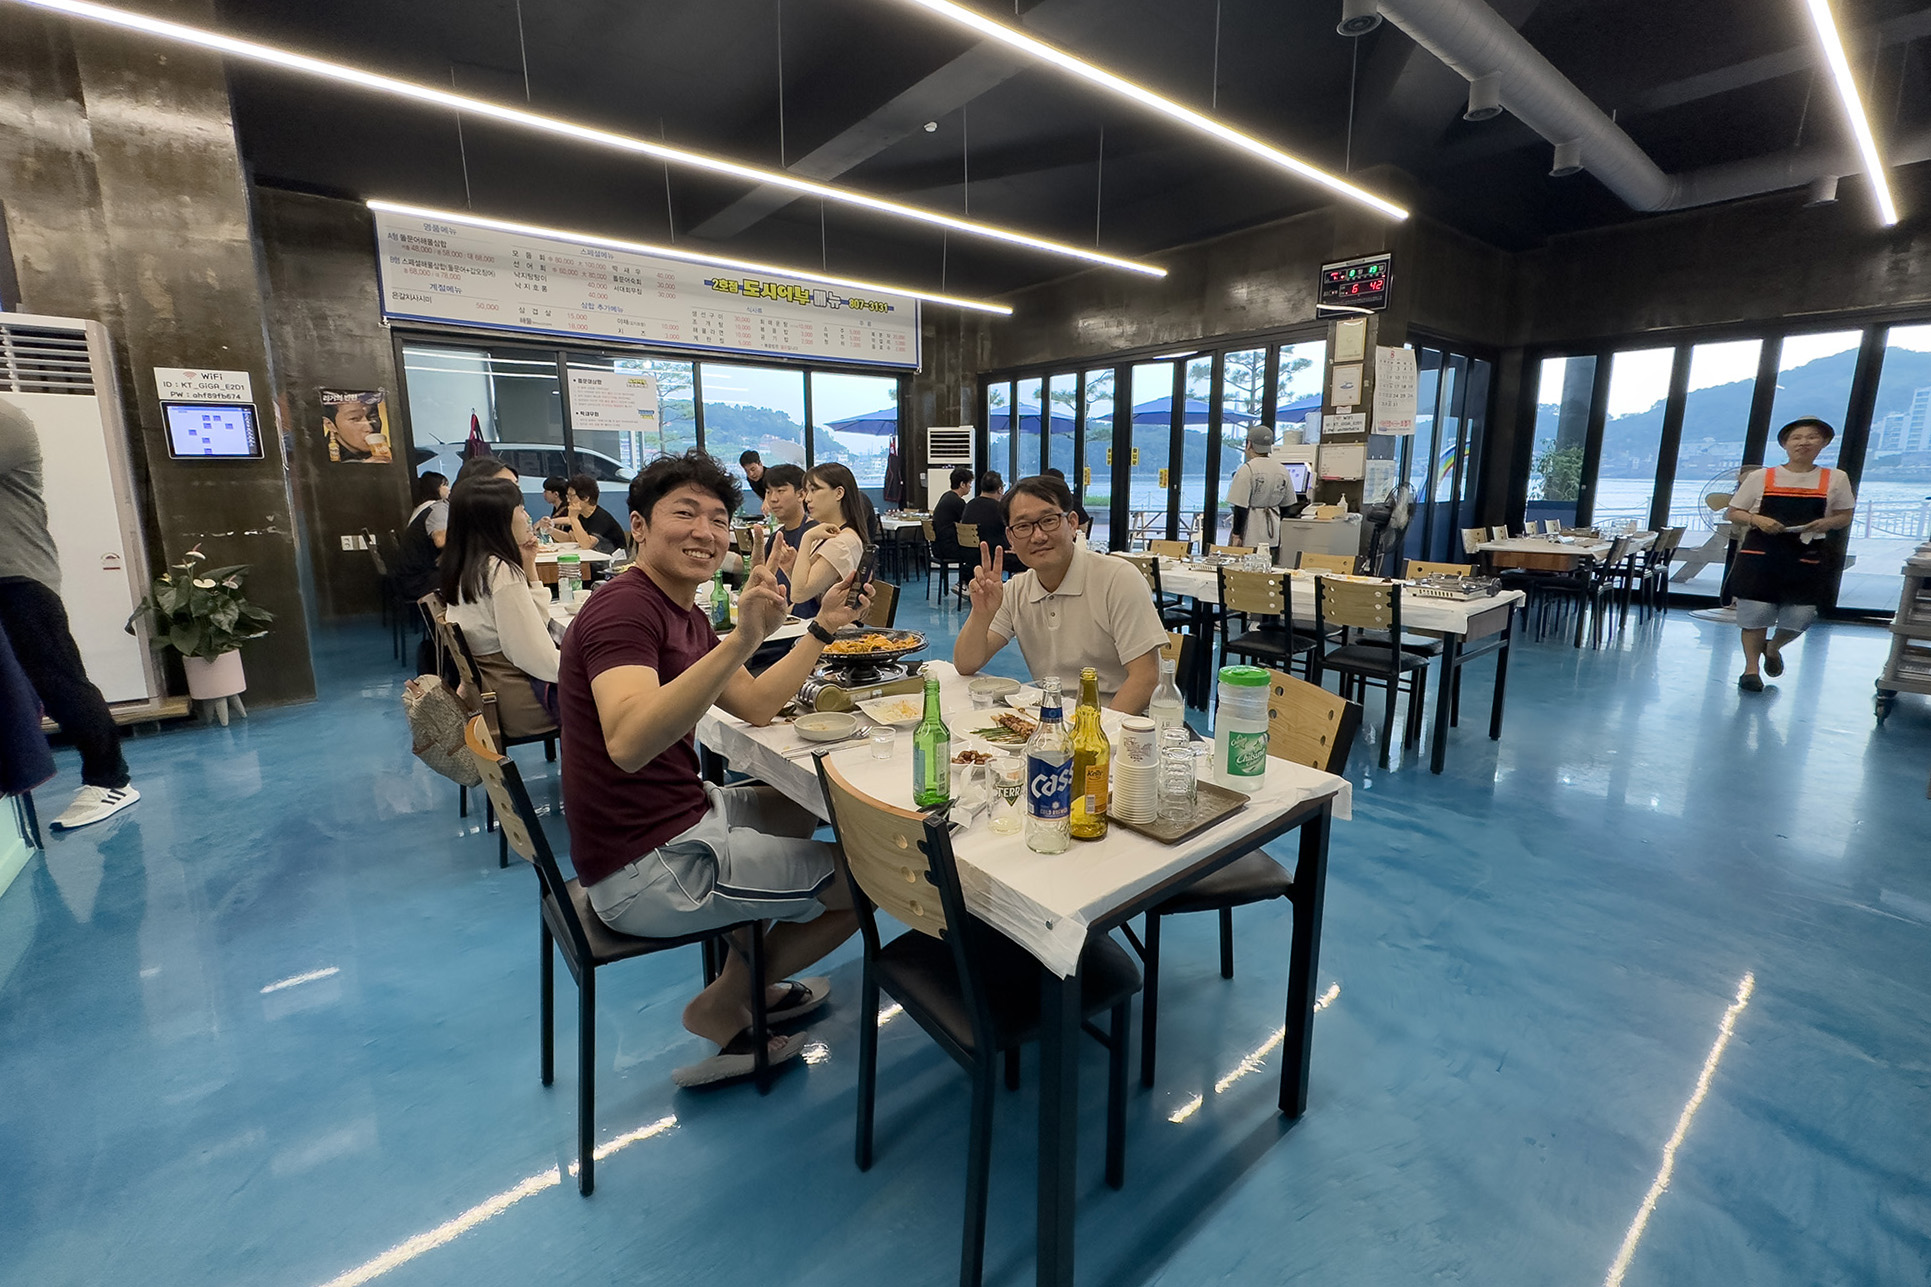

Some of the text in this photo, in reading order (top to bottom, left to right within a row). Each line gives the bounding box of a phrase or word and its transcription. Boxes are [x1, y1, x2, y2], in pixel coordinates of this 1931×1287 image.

[430, 283, 463, 295] 계절메뉴
[1351, 279, 1384, 294] 6 42
[711, 277, 889, 314] 2호점 도시어부 메뉴 807-3131
[475, 302, 499, 312] 50,000
[201, 372, 223, 381] WiFi
[1086, 769, 1103, 780] Kelly
[997, 785, 1021, 798] TERR
